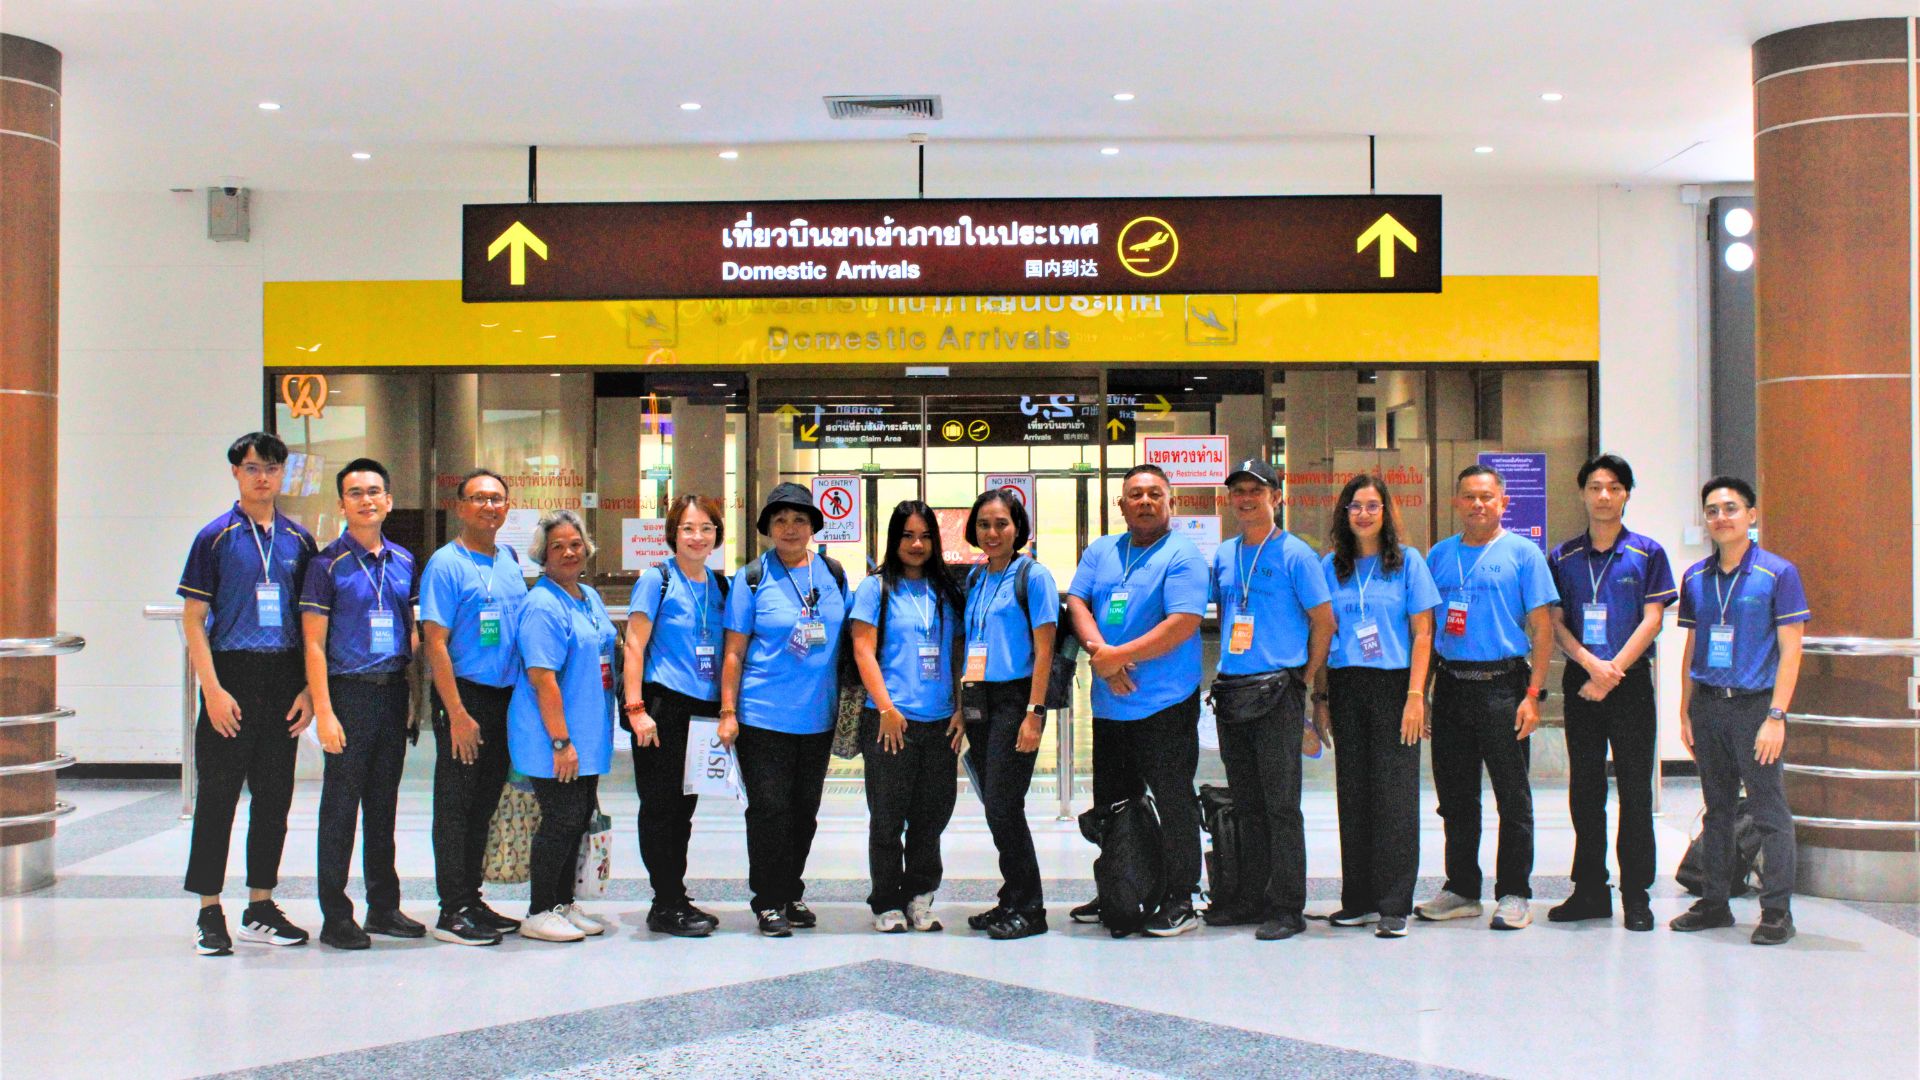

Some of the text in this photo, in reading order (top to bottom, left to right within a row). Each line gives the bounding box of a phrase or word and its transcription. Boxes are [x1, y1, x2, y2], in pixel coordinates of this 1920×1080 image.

[722, 212, 1099, 247] เที่ยวบินขาเข้าภายในประเทศ
[722, 260, 920, 280] Domestic Arrivals
[1025, 259, 1099, 278] 国内到达
[768, 325, 1071, 351] Domestic Arrivals
[825, 420, 932, 431] สถานที่รับสัมภาระเดินทง
[1027, 418, 1085, 430] เที่ยวบินขาเข้า
[825, 435, 857, 443] Baggage
[1023, 433, 1052, 441] Arrivals
[1149, 444, 1223, 463] เขตหวงห้าม
[1176, 469, 1207, 477] Restricted
[1209, 469, 1223, 477] Area
[519, 498, 581, 510] ALLOWED
[824, 530, 851, 540] ห้ามเข้า
[1447, 615, 1465, 625] DEAN
[1363, 640, 1379, 651] TAN
[700, 661, 712, 671] JAN
